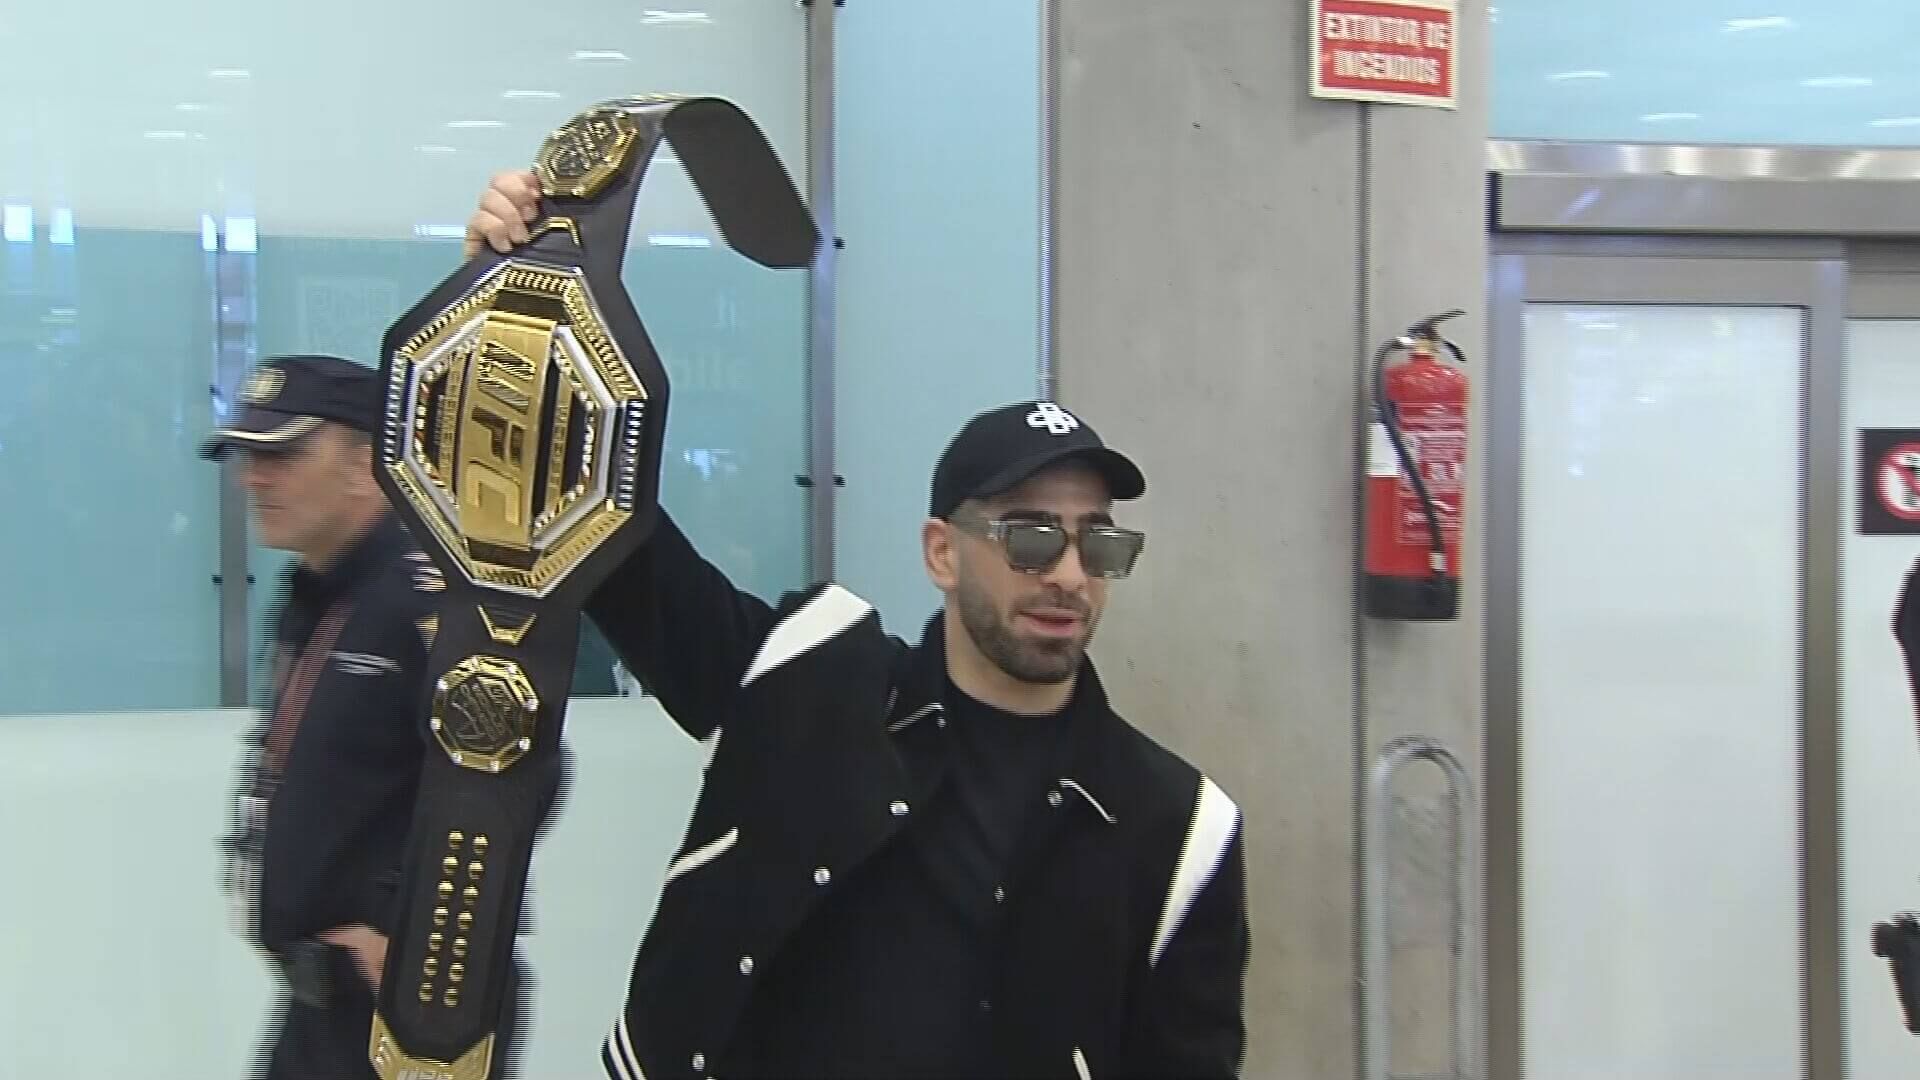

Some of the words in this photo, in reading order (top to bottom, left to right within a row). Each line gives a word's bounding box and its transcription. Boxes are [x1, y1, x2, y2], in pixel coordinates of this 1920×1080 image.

[1324, 12, 1423, 48] EXTINTOR
[1424, 22, 1450, 50] DE
[1334, 50, 1440, 85] INCENDIOS
[466, 342, 537, 527] UFC
